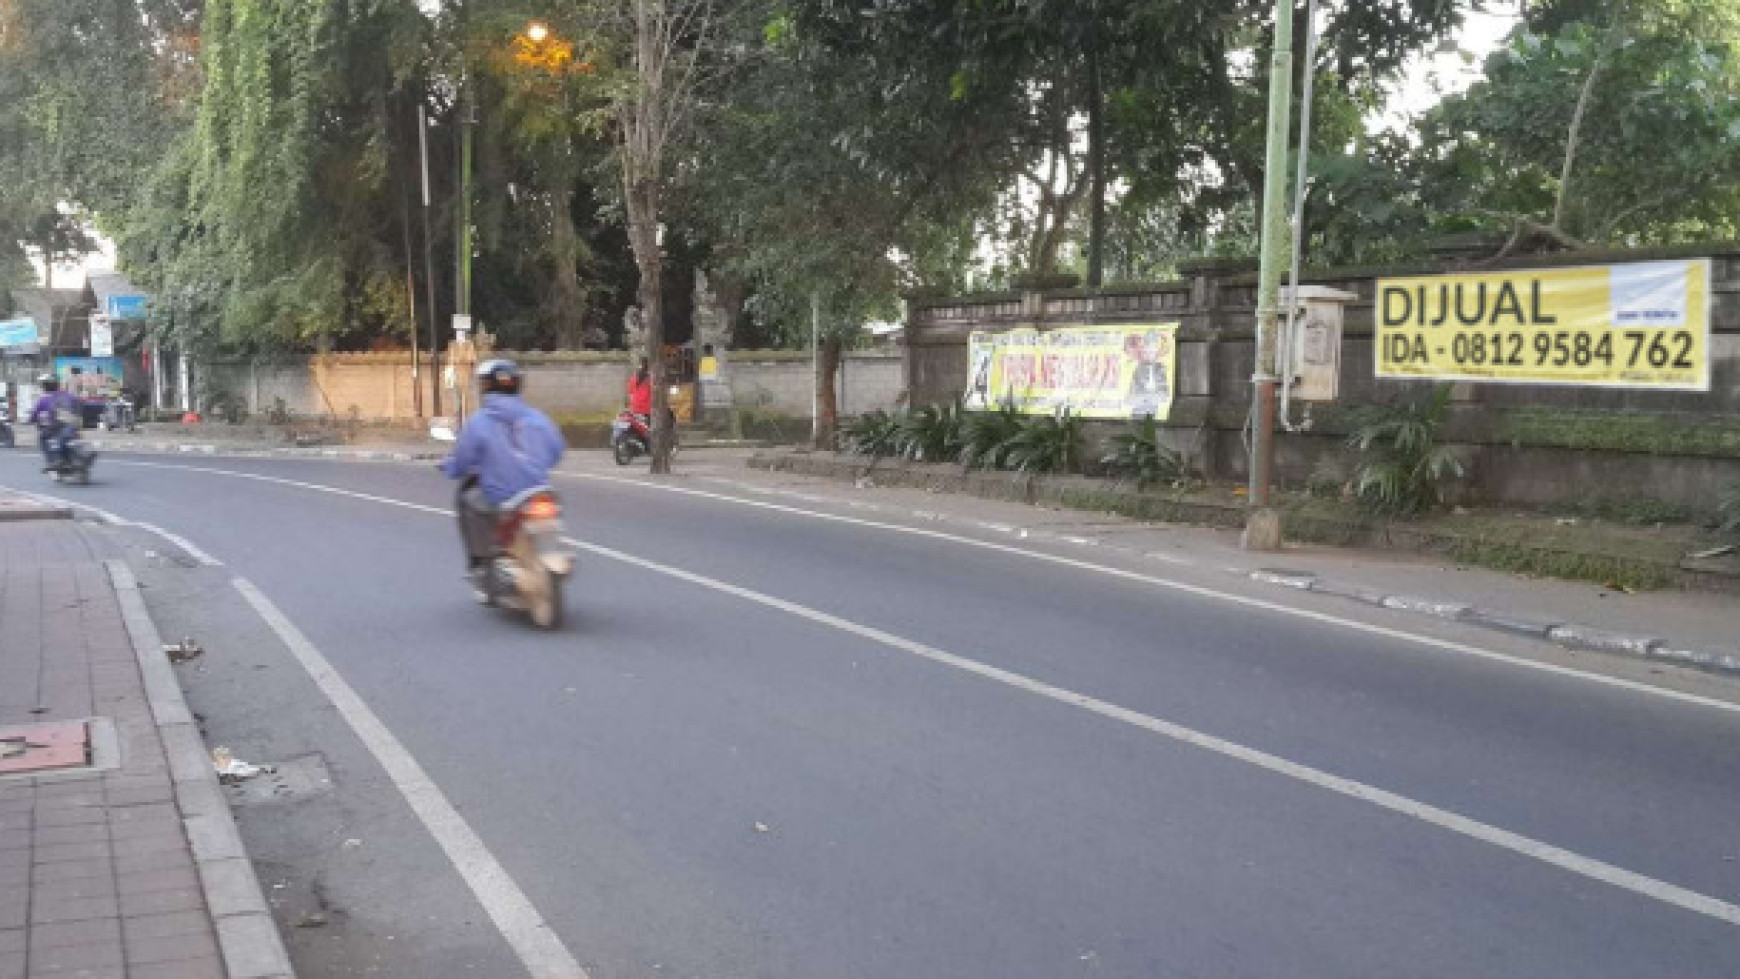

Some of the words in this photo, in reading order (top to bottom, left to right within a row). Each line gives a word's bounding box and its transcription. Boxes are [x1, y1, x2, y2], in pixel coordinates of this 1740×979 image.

[1383, 279, 1557, 327] DIJUAL
[1383, 333, 1429, 364] IDA
[1452, 332, 1524, 366] 0812
[1534, 331, 1613, 367] 9584
[1624, 331, 1694, 369] 762
